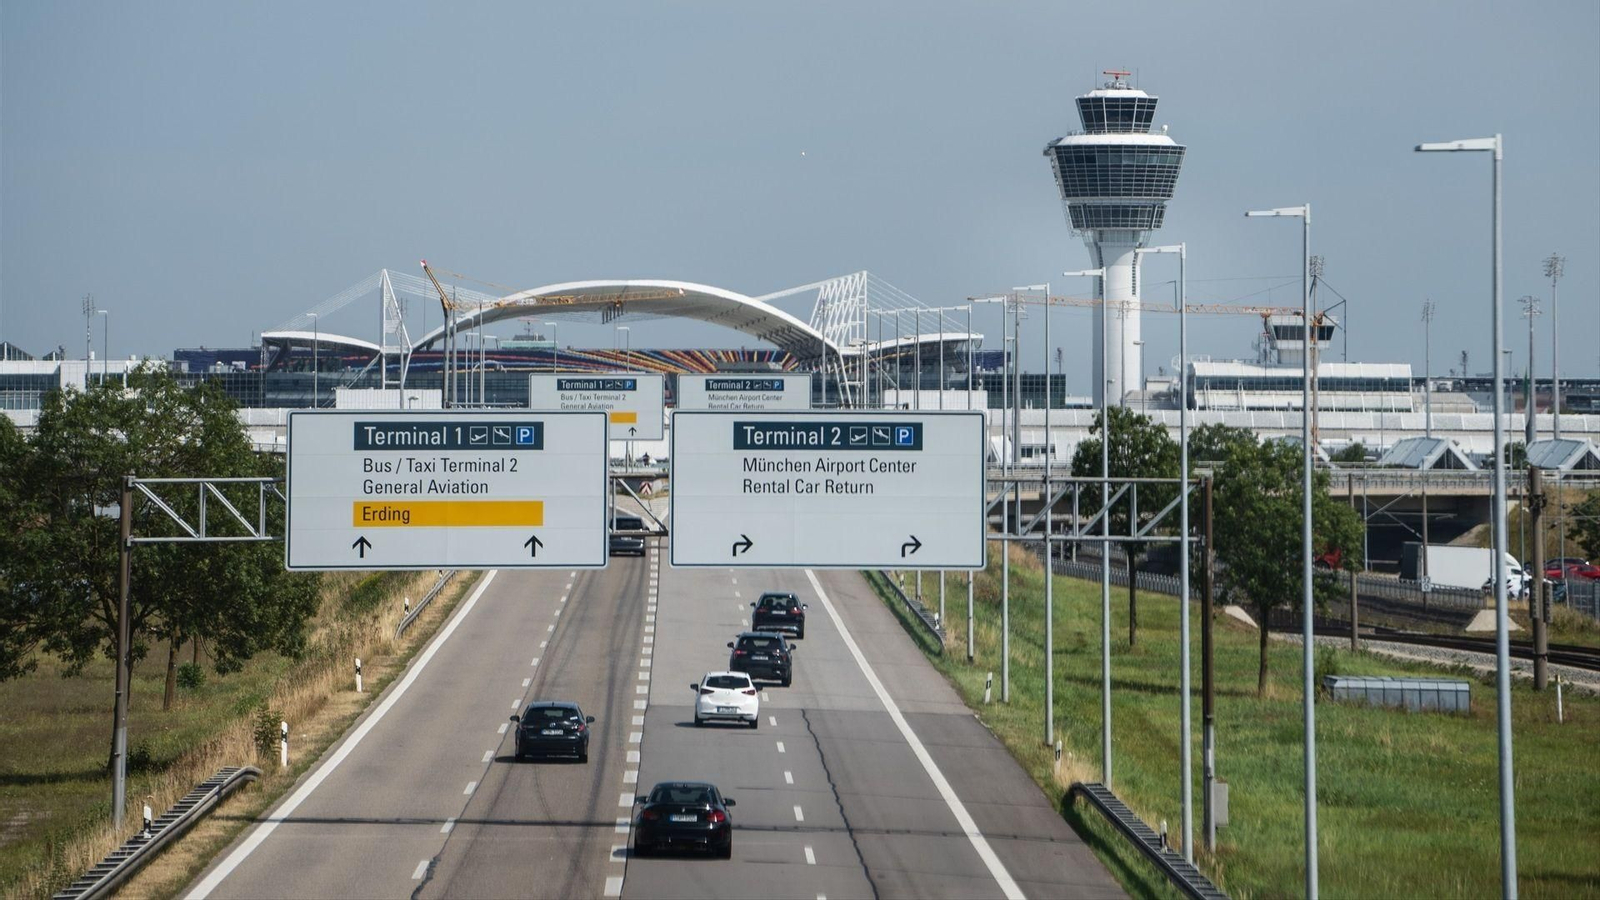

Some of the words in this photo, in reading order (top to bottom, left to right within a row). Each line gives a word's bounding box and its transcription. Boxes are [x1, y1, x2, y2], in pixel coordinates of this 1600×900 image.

[561, 380, 597, 389] Terminal
[599, 380, 603, 389] 1
[709, 380, 744, 390] Terminal
[746, 380, 751, 390] 2
[739, 394, 761, 402] Airport
[363, 426, 447, 445] Terminal
[455, 427, 462, 445] 1
[520, 428, 530, 443] P
[743, 426, 824, 445] Terminal
[831, 426, 841, 446] 2
[900, 428, 910, 443] P
[363, 458, 392, 473] Bus
[395, 458, 402, 476] /
[406, 457, 436, 473] Taxi
[441, 457, 505, 473] Terminal
[509, 458, 518, 473] 2
[743, 457, 811, 473] München
[815, 457, 865, 476] Airport
[869, 458, 917, 473] Center
[363, 480, 423, 495] General
[427, 479, 489, 494] Aviation
[743, 479, 790, 494] Rental
[795, 479, 820, 494] Car
[825, 479, 874, 494] Return
[362, 506, 411, 524] Erding
